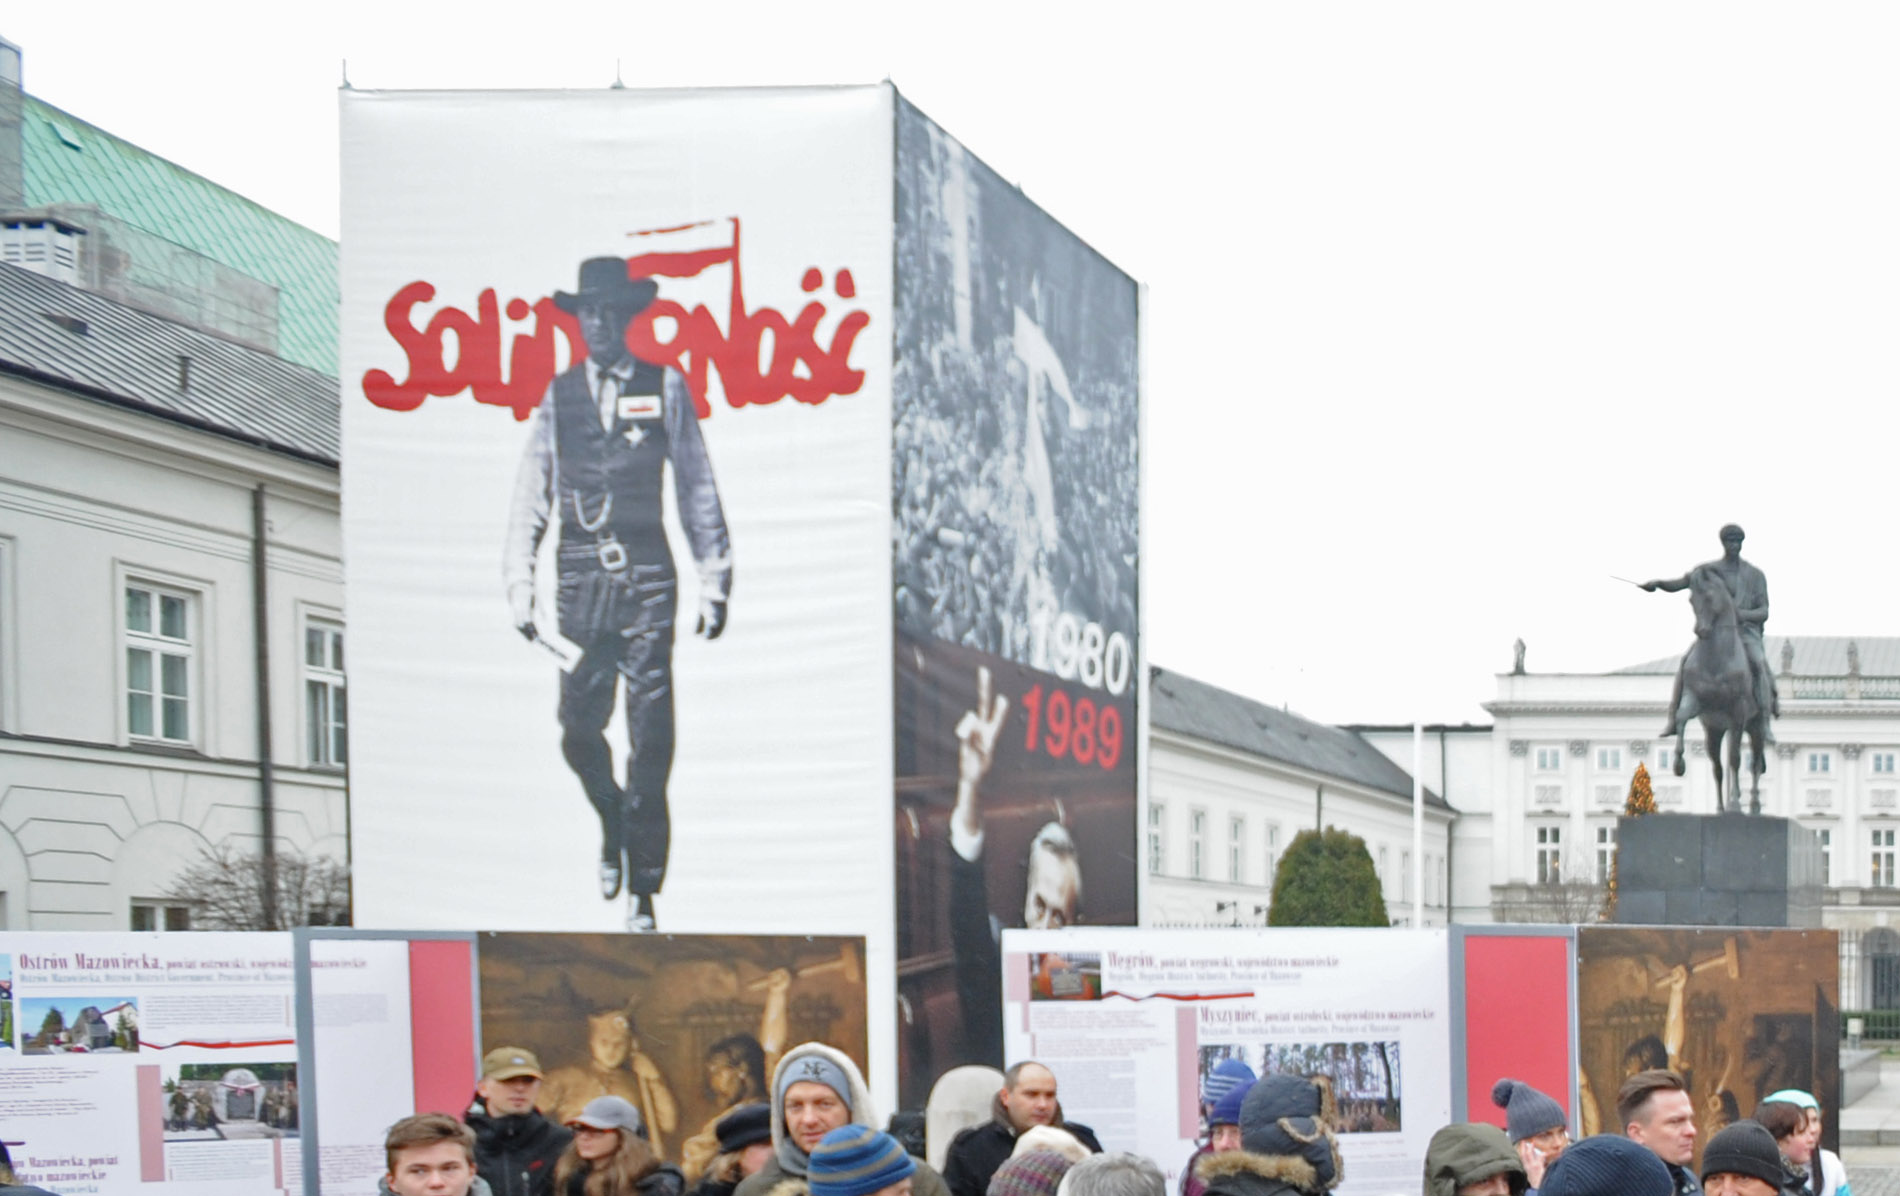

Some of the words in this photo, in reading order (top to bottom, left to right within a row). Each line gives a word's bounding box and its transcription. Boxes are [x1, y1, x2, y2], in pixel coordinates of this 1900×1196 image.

[362, 262, 870, 422] SOLIDRNOŚĆ
[1029, 610, 1131, 696] 1980
[1021, 683, 1124, 772] 1989
[20, 952, 68, 970] Ostrów
[75, 952, 163, 971] Mazowiecka,
